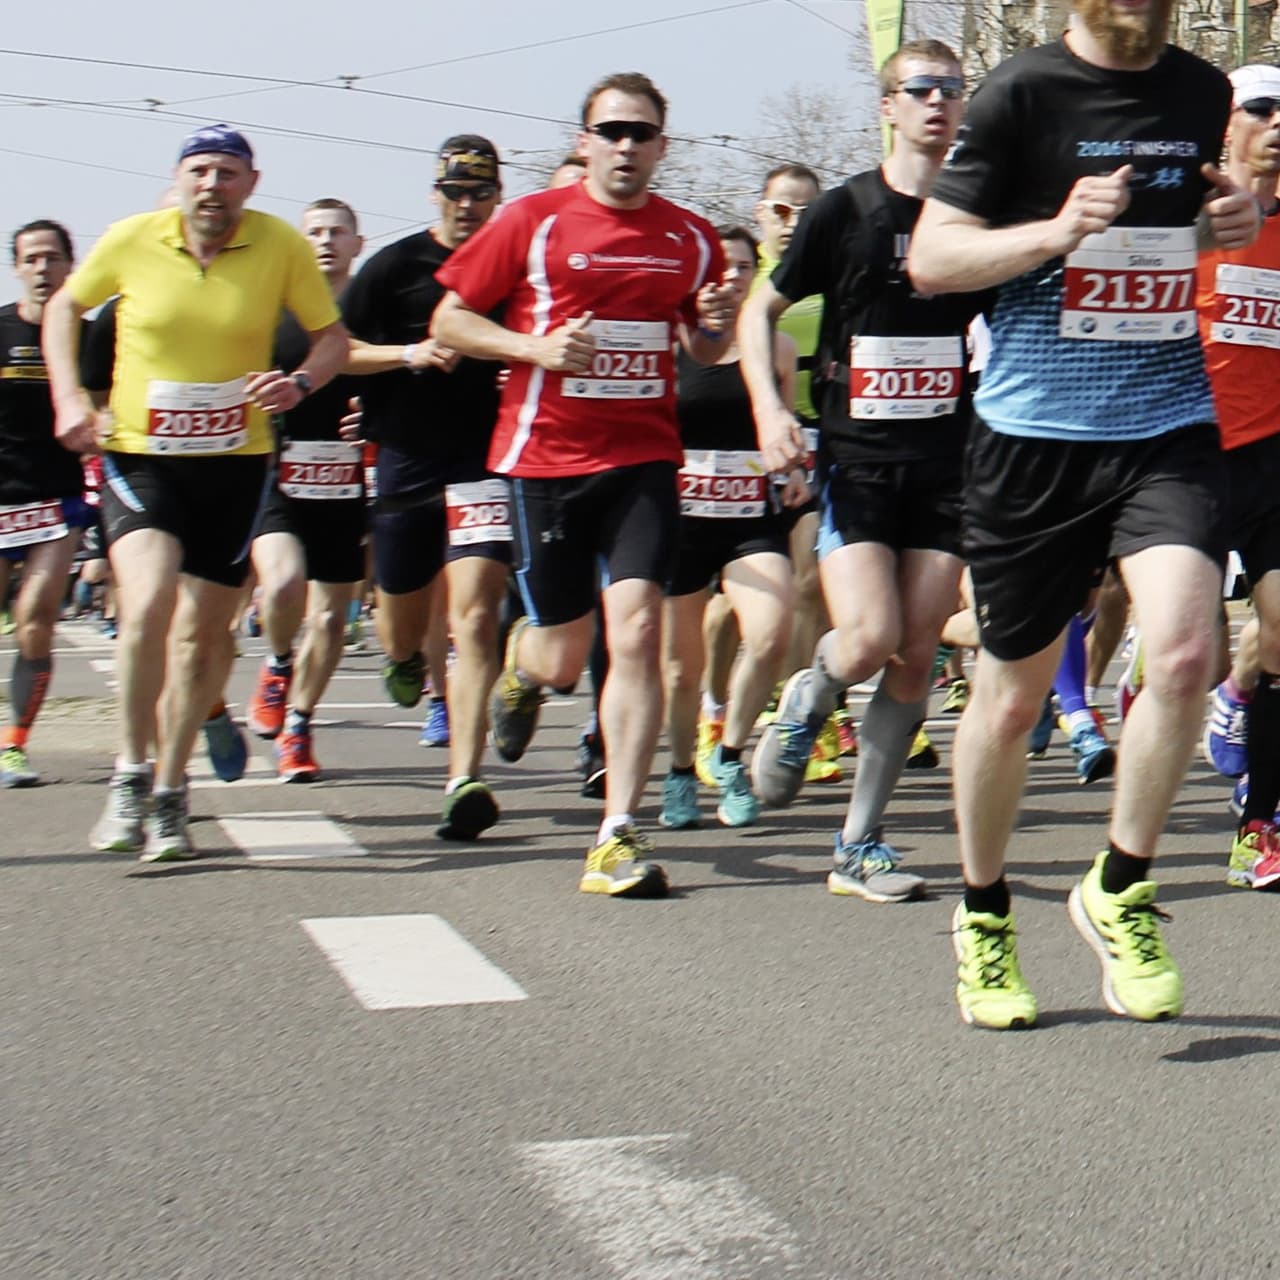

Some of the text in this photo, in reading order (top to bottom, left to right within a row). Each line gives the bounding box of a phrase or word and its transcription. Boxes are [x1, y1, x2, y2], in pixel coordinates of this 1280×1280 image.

[1127, 255, 1165, 267] Silvio
[1078, 272, 1194, 310] 21377
[575, 352, 660, 378] 0241
[861, 370, 955, 397] 20129
[153, 409, 243, 435] 20322
[288, 464, 357, 484] 21607
[680, 476, 760, 500] 21904
